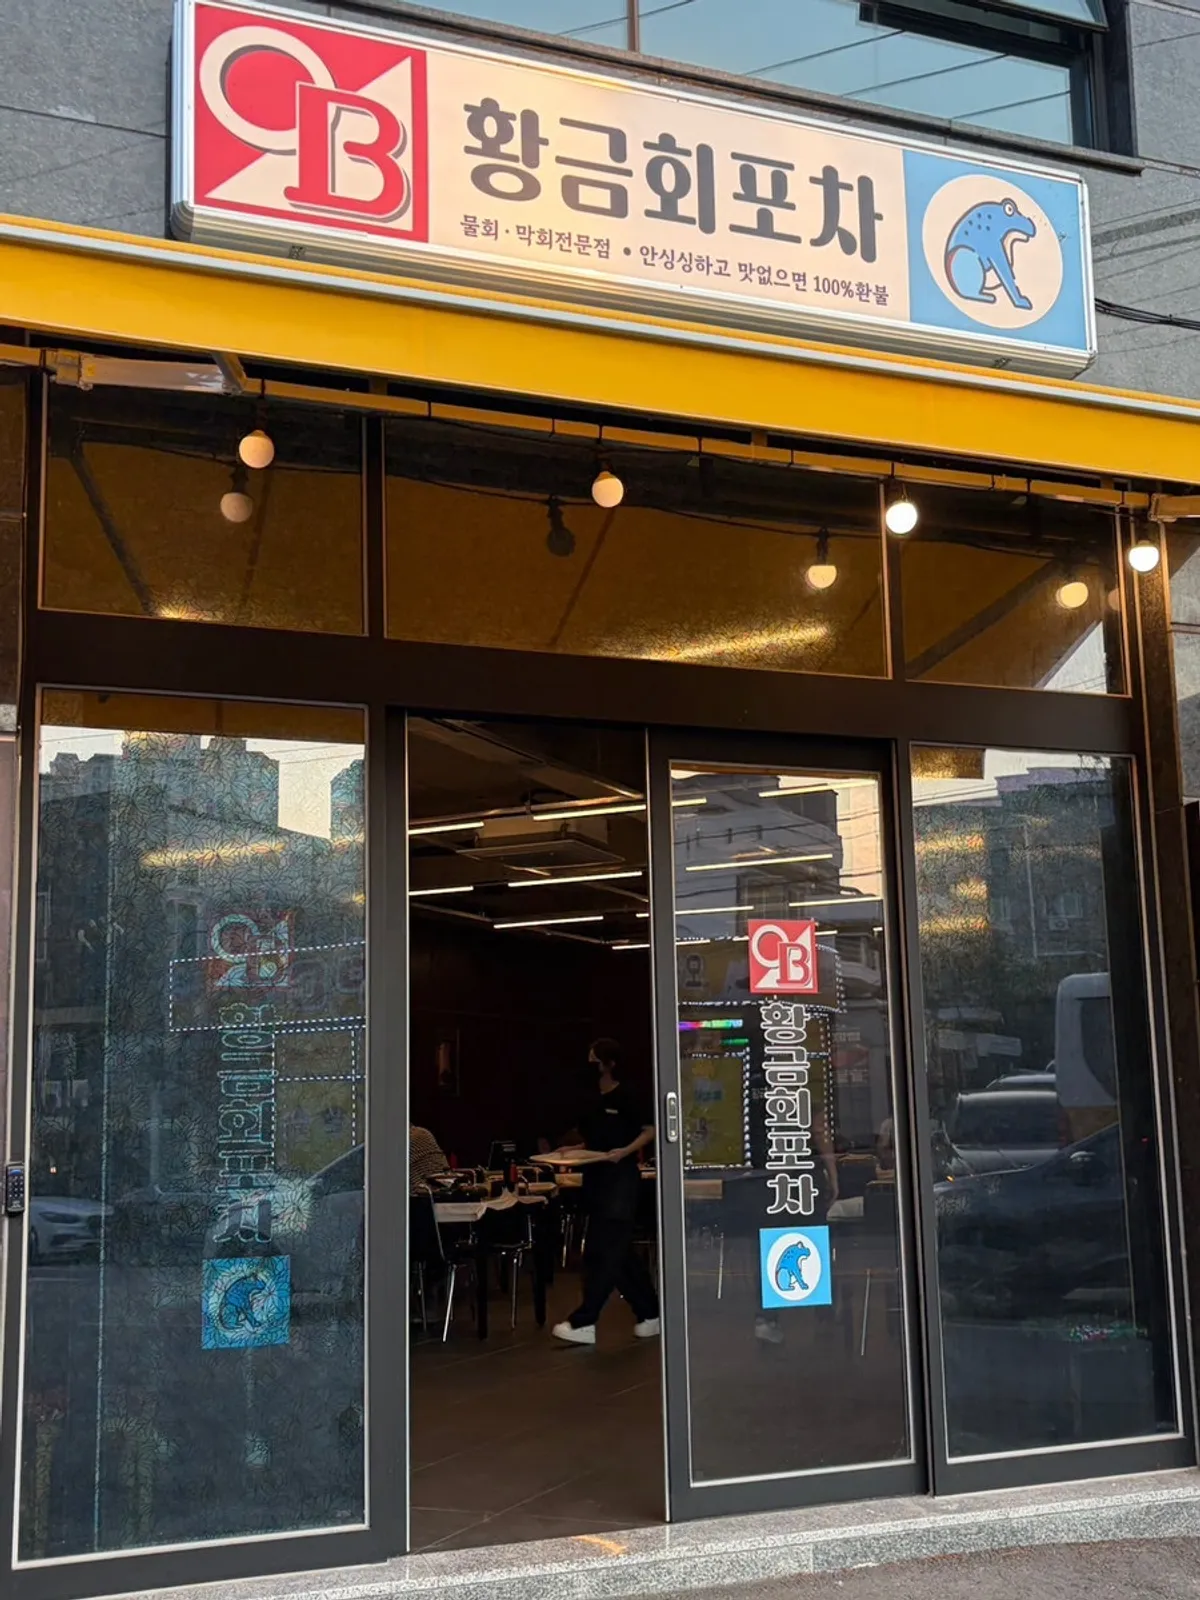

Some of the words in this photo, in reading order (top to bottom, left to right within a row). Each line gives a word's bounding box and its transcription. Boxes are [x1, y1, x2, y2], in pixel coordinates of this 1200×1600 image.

[463, 97, 883, 263] 황금회포차
[639, 244, 731, 278] 안싱싱하고
[738, 261, 808, 292] 맛없으면
[813, 275, 890, 307] 100%환불
[760, 1002, 820, 1216] 황금회포차
